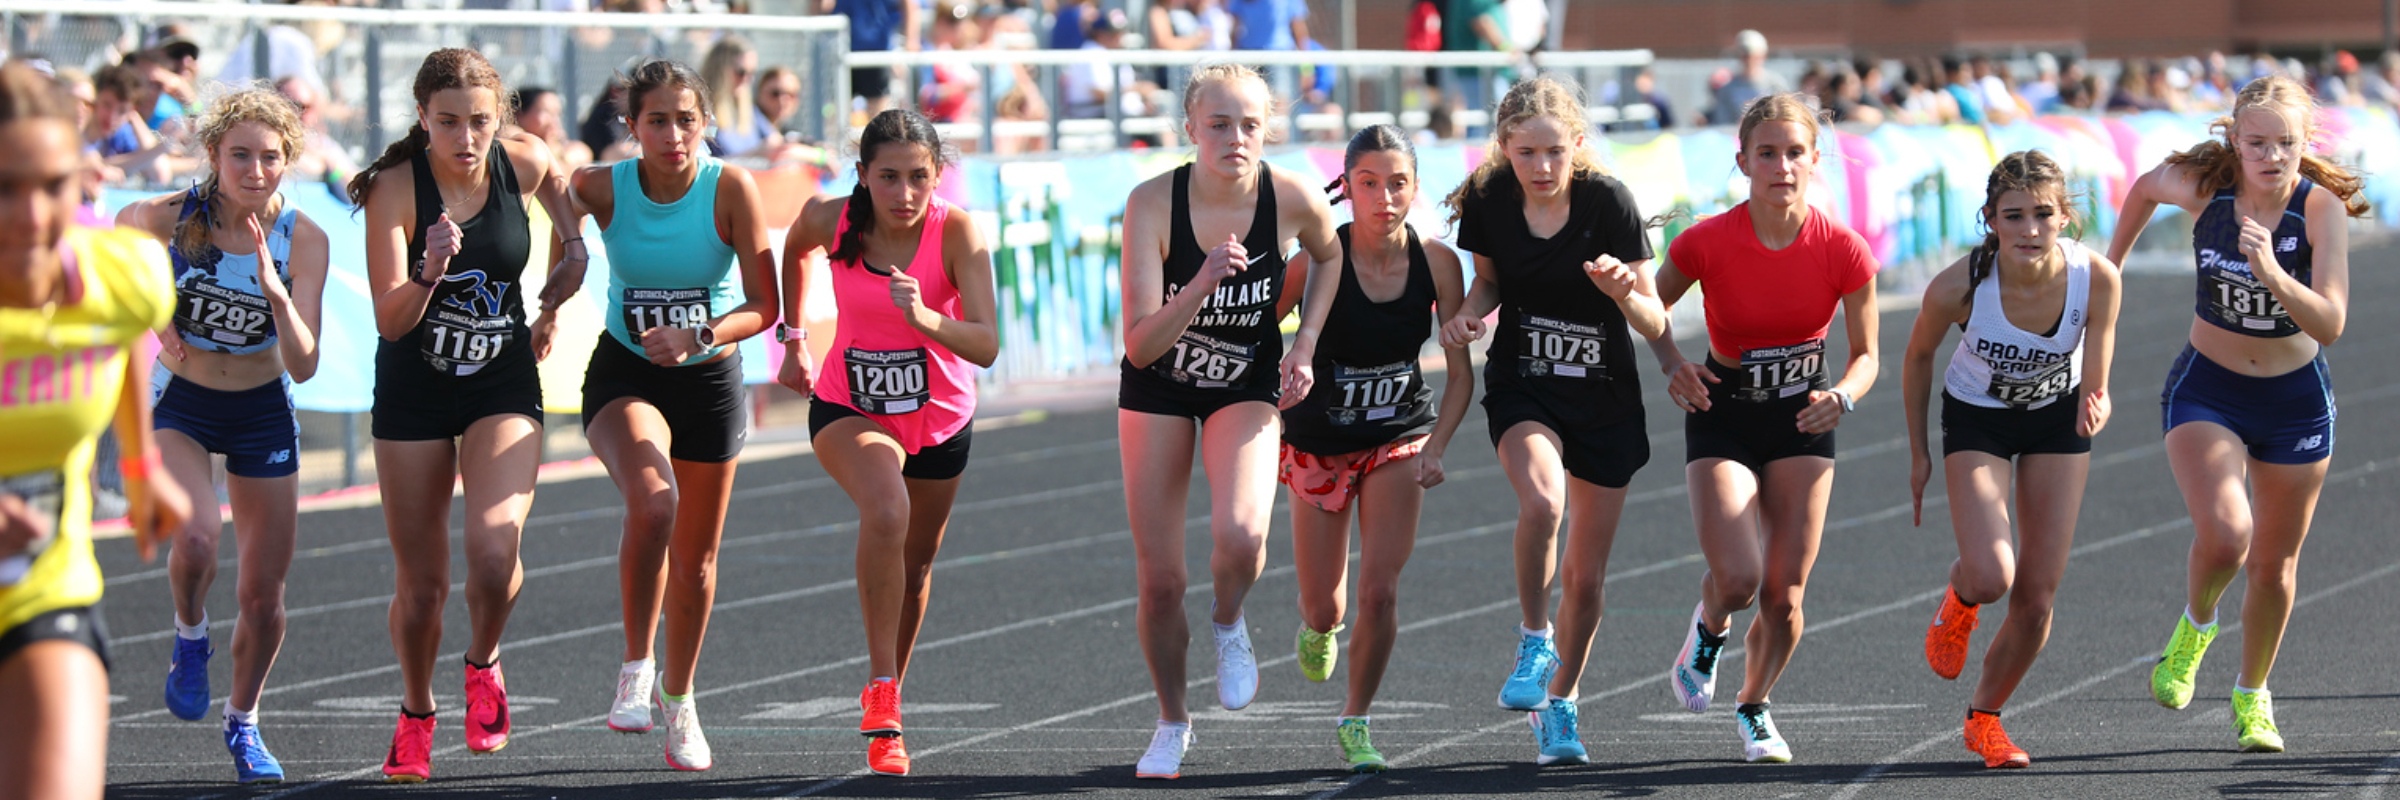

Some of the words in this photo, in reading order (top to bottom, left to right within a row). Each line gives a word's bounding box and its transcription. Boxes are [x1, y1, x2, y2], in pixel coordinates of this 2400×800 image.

[190, 297, 267, 334] 1292
[630, 304, 707, 332] 1199
[433, 326, 503, 361] 1191
[1528, 331, 1600, 365] 1073
[1976, 338, 2073, 364] PROJECT
[1174, 342, 1248, 381] 1267
[1749, 354, 1819, 388] 1120
[852, 364, 924, 396] 1200
[1343, 375, 1410, 407] 1107
